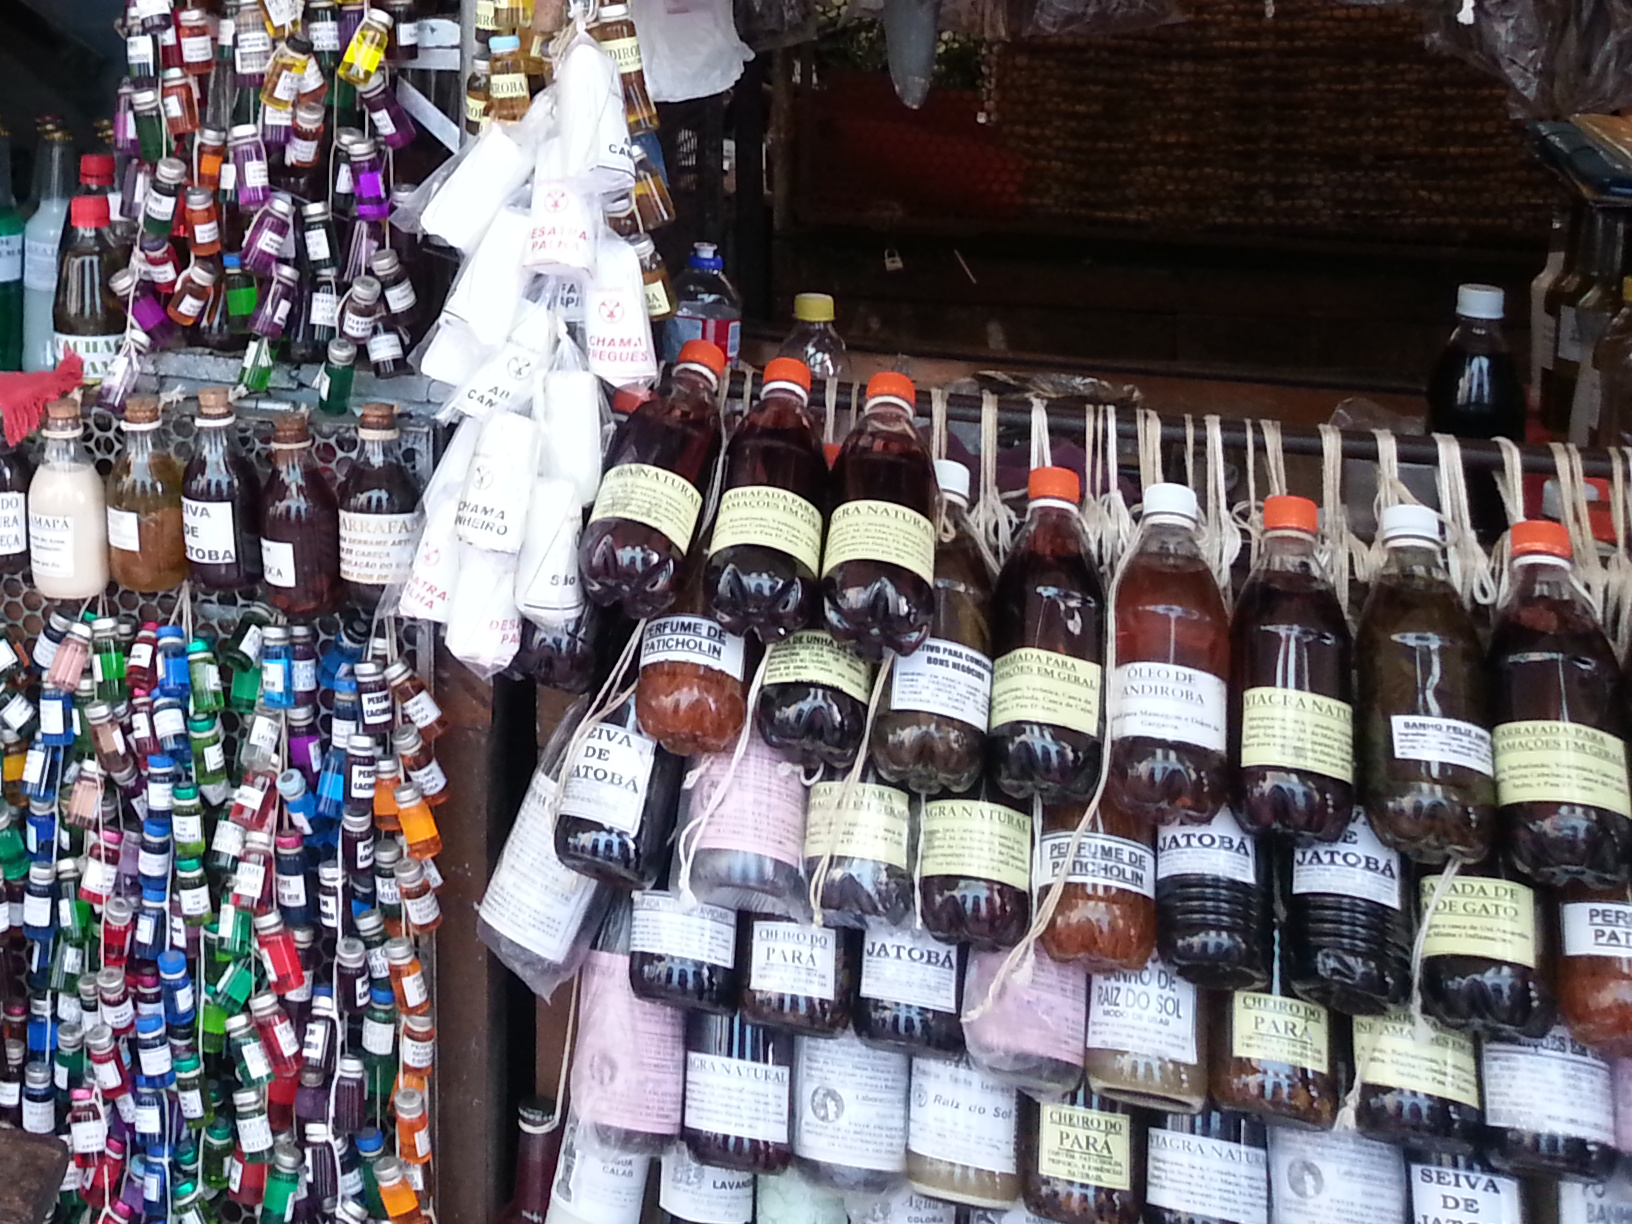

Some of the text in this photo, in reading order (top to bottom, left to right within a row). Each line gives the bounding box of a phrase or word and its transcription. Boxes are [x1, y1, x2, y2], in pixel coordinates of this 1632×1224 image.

[645, 635, 723, 658] PATICHOLIN
[706, 627, 727, 645] DE
[583, 745, 610, 761] DE
[1049, 842, 1115, 865] PEFUME
[1119, 850, 1147, 868] DE
[1159, 832, 1252, 857] JATOBÁ
[1051, 858, 1145, 887] PTICHOLIN
[1296, 848, 1397, 877] JATOBÁ
[765, 945, 816, 967] PARÁ
[867, 942, 954, 969] JATOBÁ
[1125, 989, 1151, 1010] DO
[1155, 993, 1182, 1019] SOL
[1049, 1110, 1102, 1129] CHEIRO
[1059, 1130, 1112, 1155] PARÁ
[1420, 1168, 1501, 1195] SEIVA
[1442, 1194, 1480, 1214] DE
